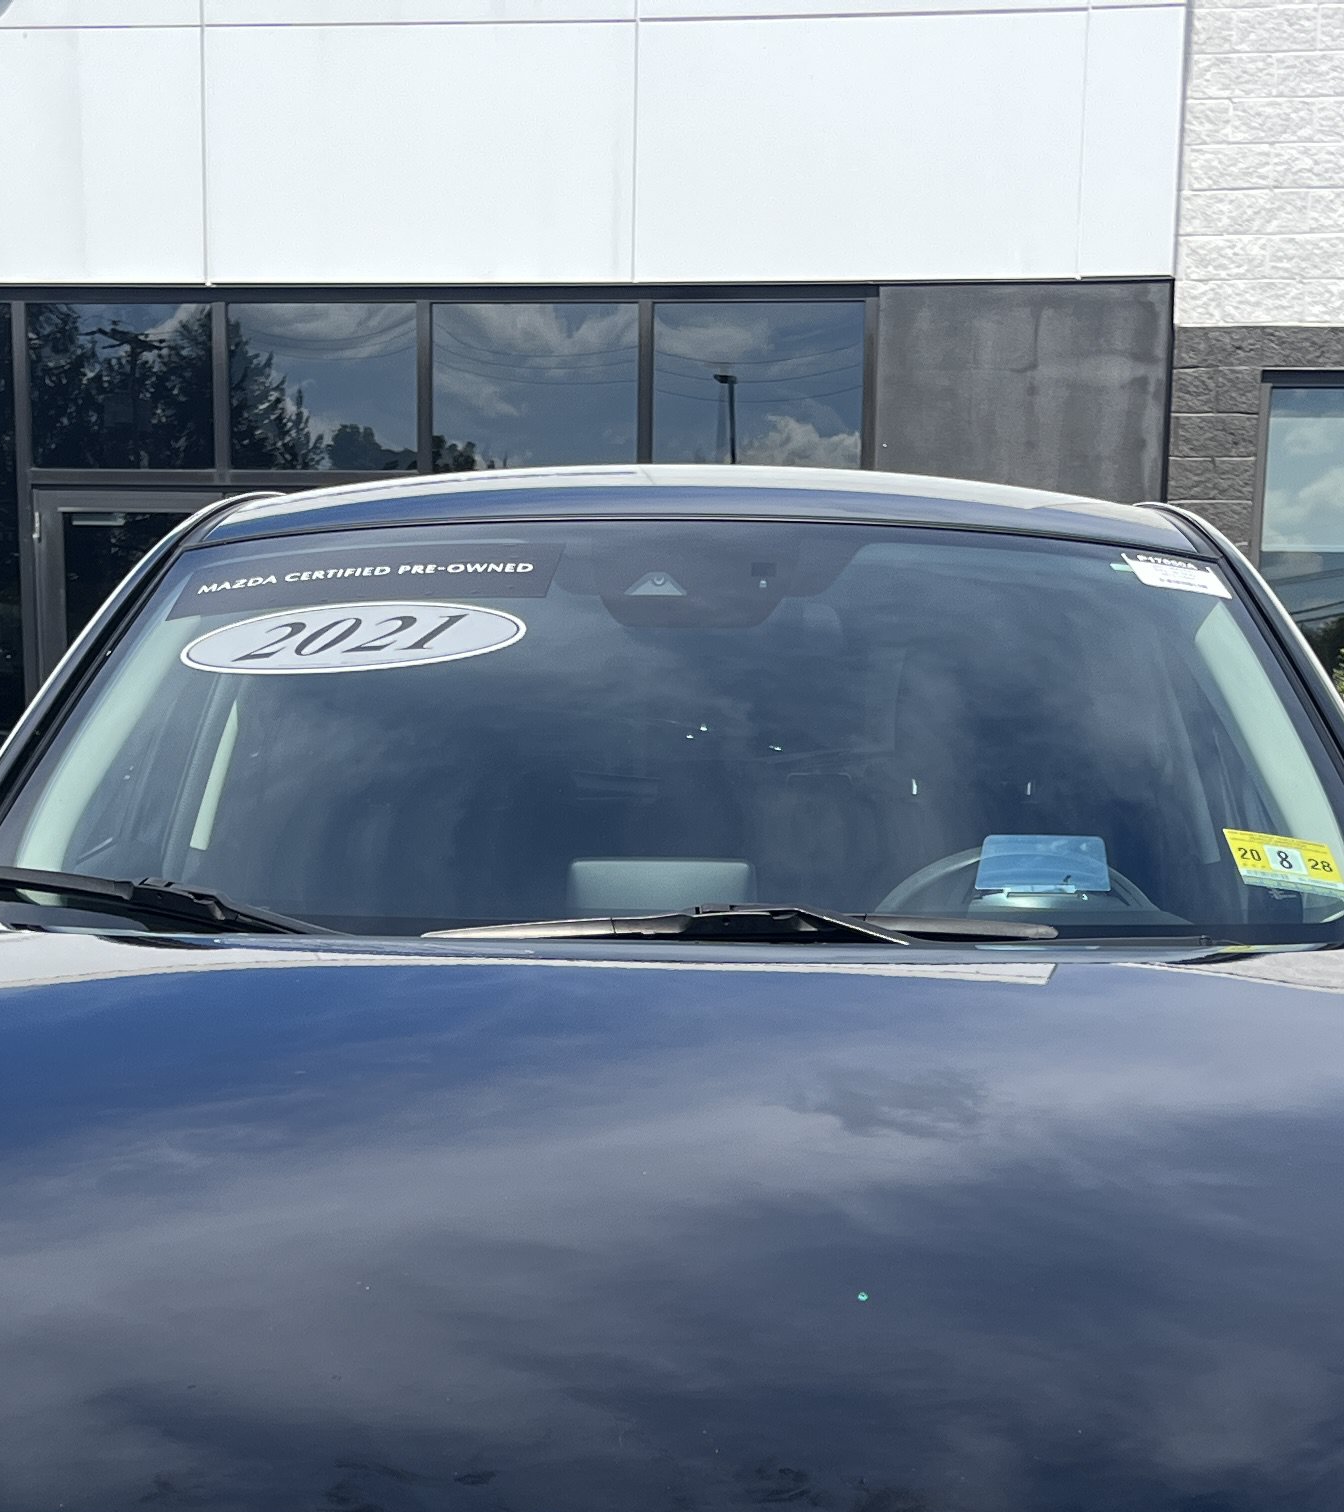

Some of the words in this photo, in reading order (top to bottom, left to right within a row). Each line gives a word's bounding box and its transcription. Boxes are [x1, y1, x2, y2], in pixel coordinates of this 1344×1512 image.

[197, 575, 277, 595] MAZDA
[284, 566, 391, 582] CERTIFIED
[398, 562, 534, 575] PRE-OWNED
[231, 613, 469, 663] 2021
[1237, 847, 1261, 861] 20
[1276, 850, 1293, 869] 8
[1307, 858, 1333, 873] 28
